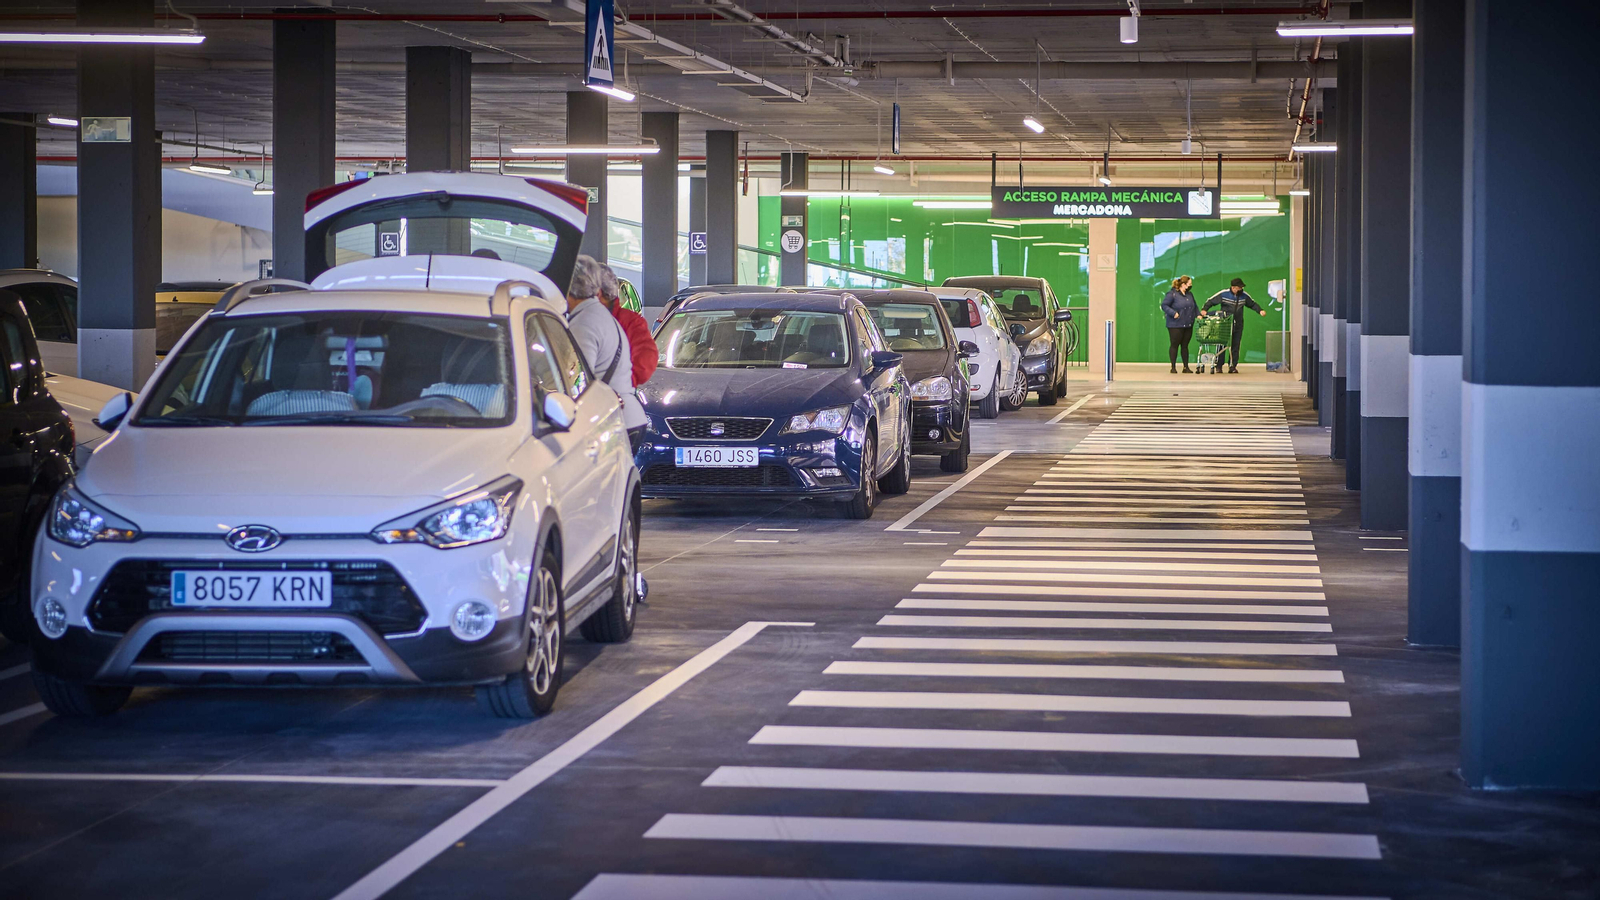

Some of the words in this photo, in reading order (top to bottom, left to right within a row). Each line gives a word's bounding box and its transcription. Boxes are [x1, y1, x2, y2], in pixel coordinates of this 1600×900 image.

[1003, 191, 1058, 203] ACCESO
[1061, 191, 1108, 203] RAMPA
[1112, 190, 1184, 203] MECÁNICA
[1052, 204, 1133, 216] MERCADONA
[687, 449, 722, 463] 1460
[727, 449, 754, 463] JSS
[193, 576, 261, 601] 8057
[273, 576, 324, 601] KRN
